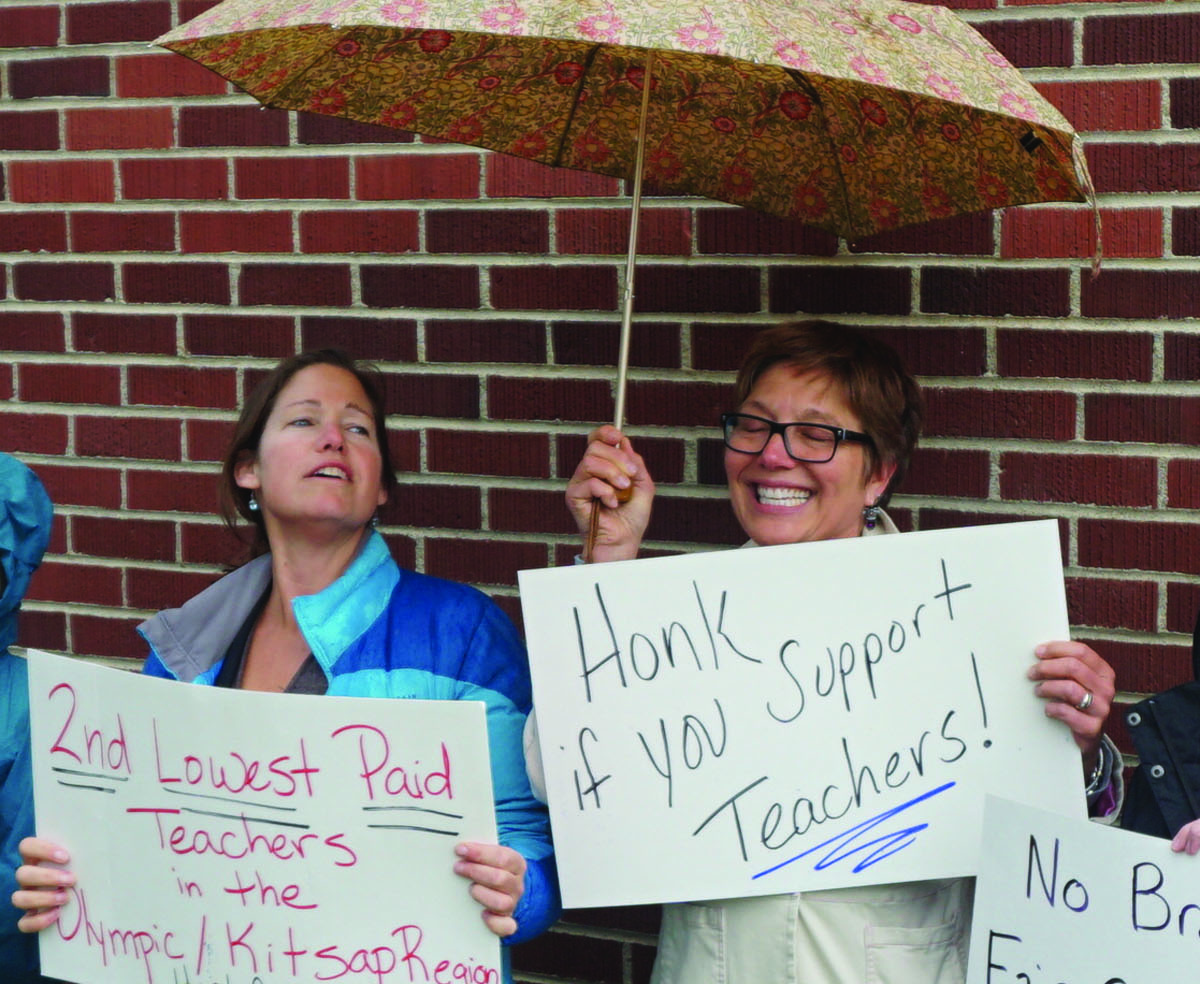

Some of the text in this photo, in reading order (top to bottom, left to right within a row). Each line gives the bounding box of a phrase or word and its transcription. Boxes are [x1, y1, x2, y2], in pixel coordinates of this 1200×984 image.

[49, 683, 453, 799] 2nd Lowest Paid
[559, 727, 611, 809] if
[692, 652, 993, 862] Teachers!
[126, 808, 357, 866] Teachers
[1026, 835, 1089, 912] No
[172, 868, 318, 909] in the
